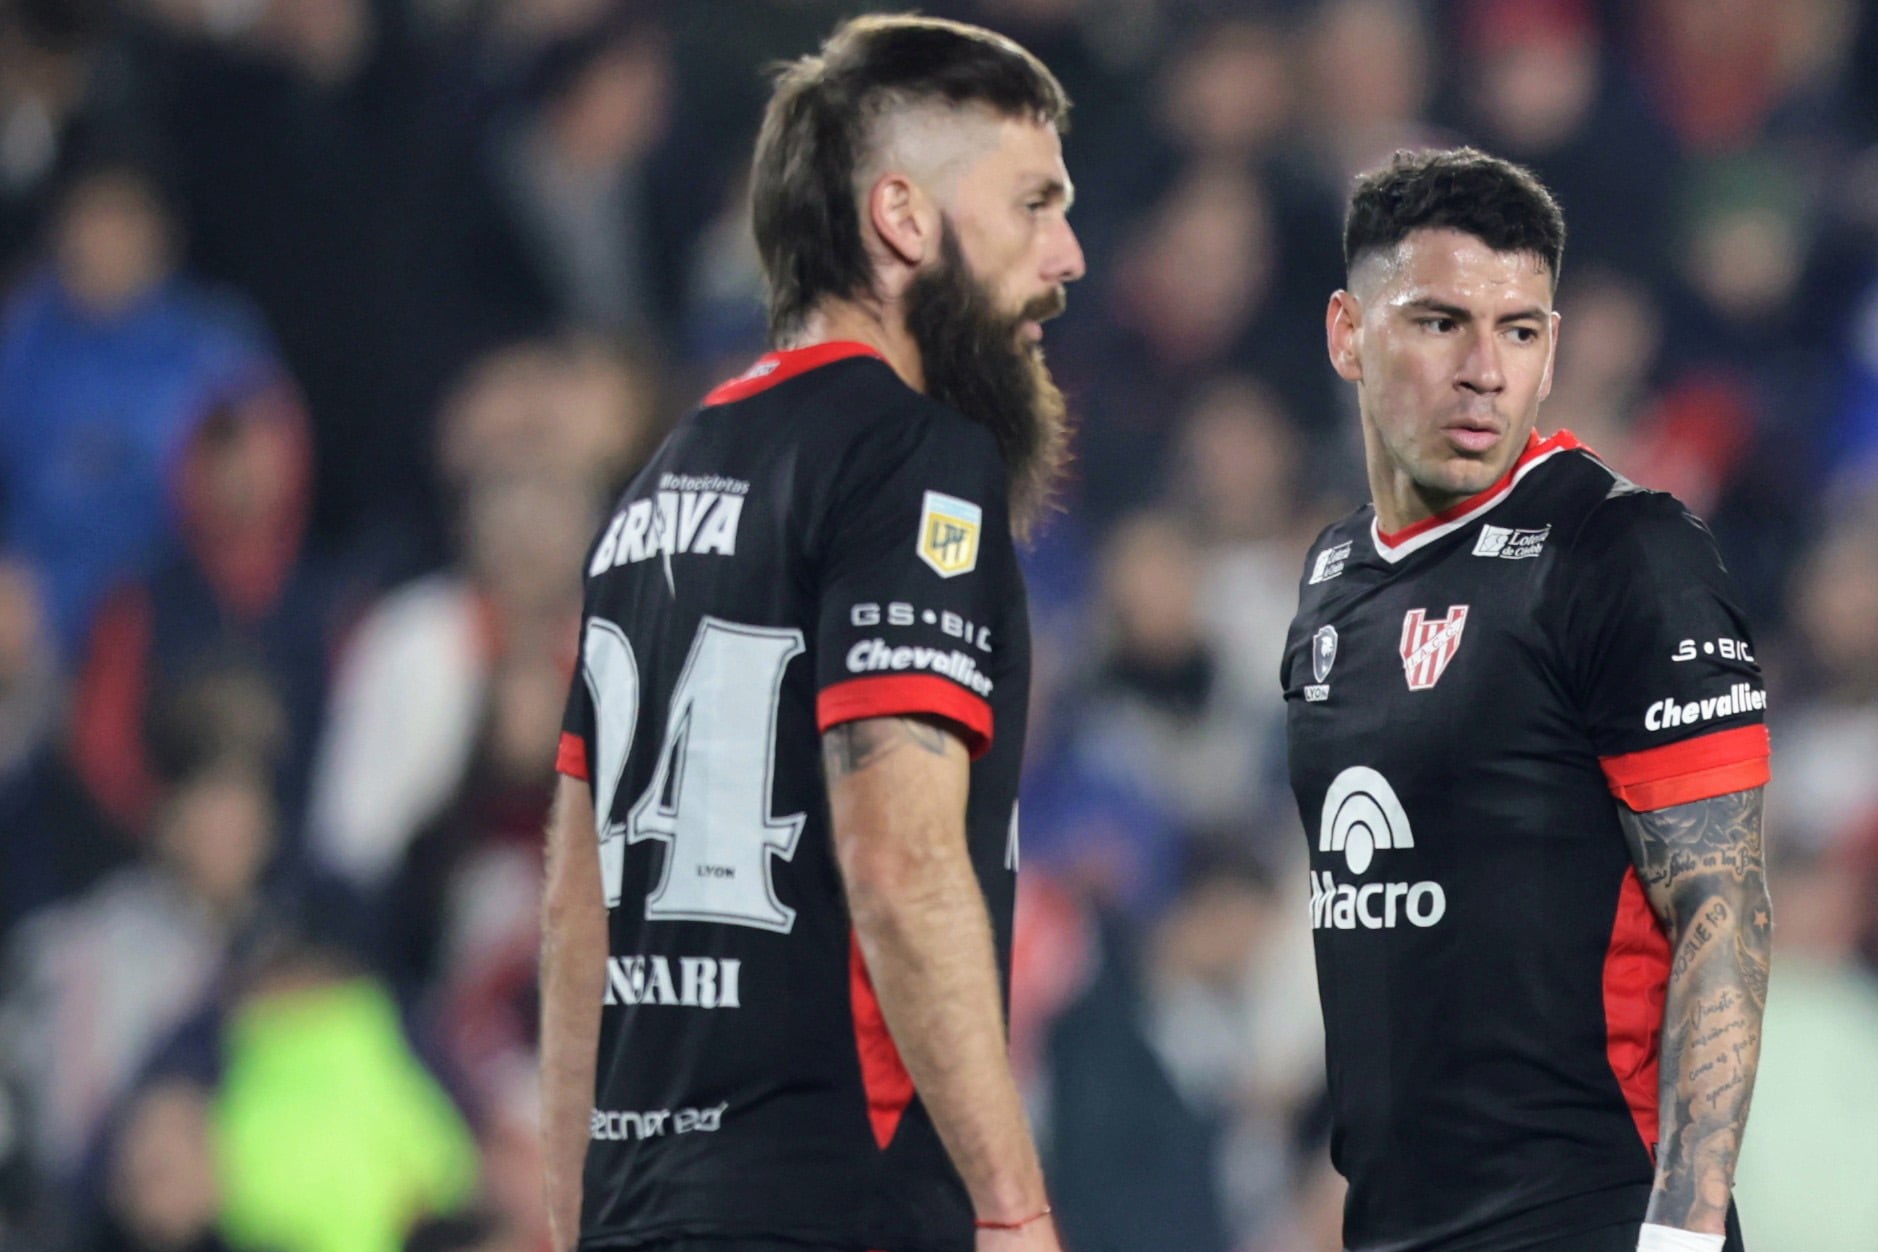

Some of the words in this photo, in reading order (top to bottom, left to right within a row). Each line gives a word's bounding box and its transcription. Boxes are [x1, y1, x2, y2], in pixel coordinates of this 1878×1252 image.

[589, 490, 745, 579] BRAVA
[846, 637, 994, 698] Chevallier
[583, 616, 807, 934] 24
[697, 865, 735, 879] LYON
[1309, 870, 1446, 930] Macro
